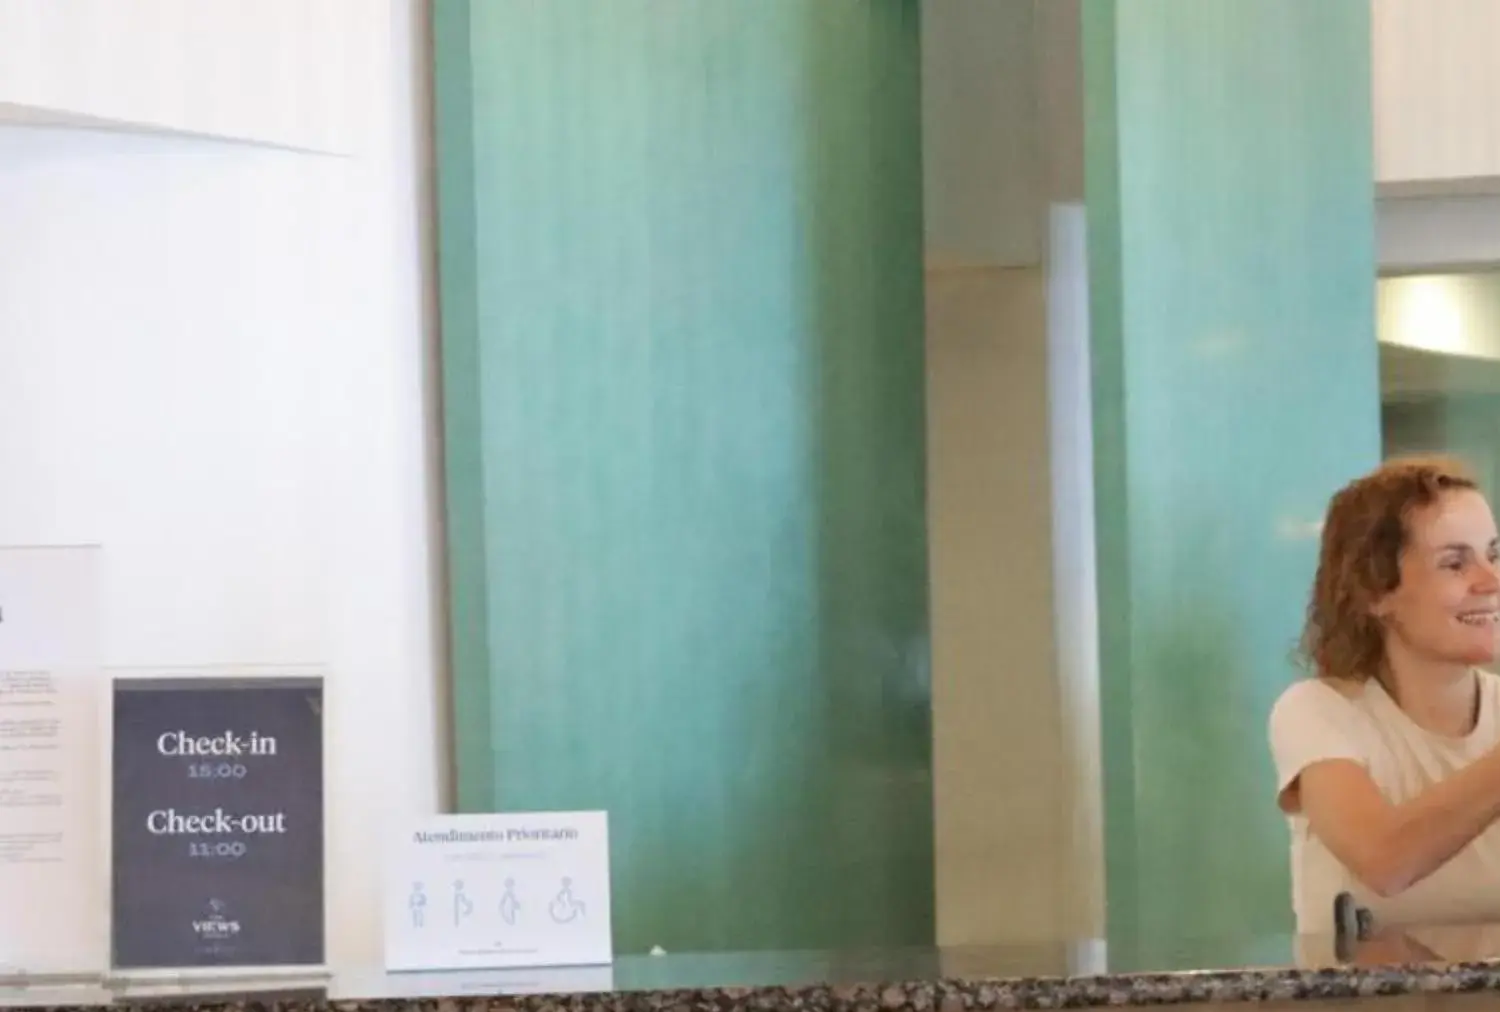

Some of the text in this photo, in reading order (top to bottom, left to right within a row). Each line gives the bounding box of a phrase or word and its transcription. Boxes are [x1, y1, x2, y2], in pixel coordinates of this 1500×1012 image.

[157, 730, 277, 755] Check-in
[188, 764, 247, 778] 15:00
[147, 808, 287, 834] Check-out
[189, 842, 247, 857] 11:00
